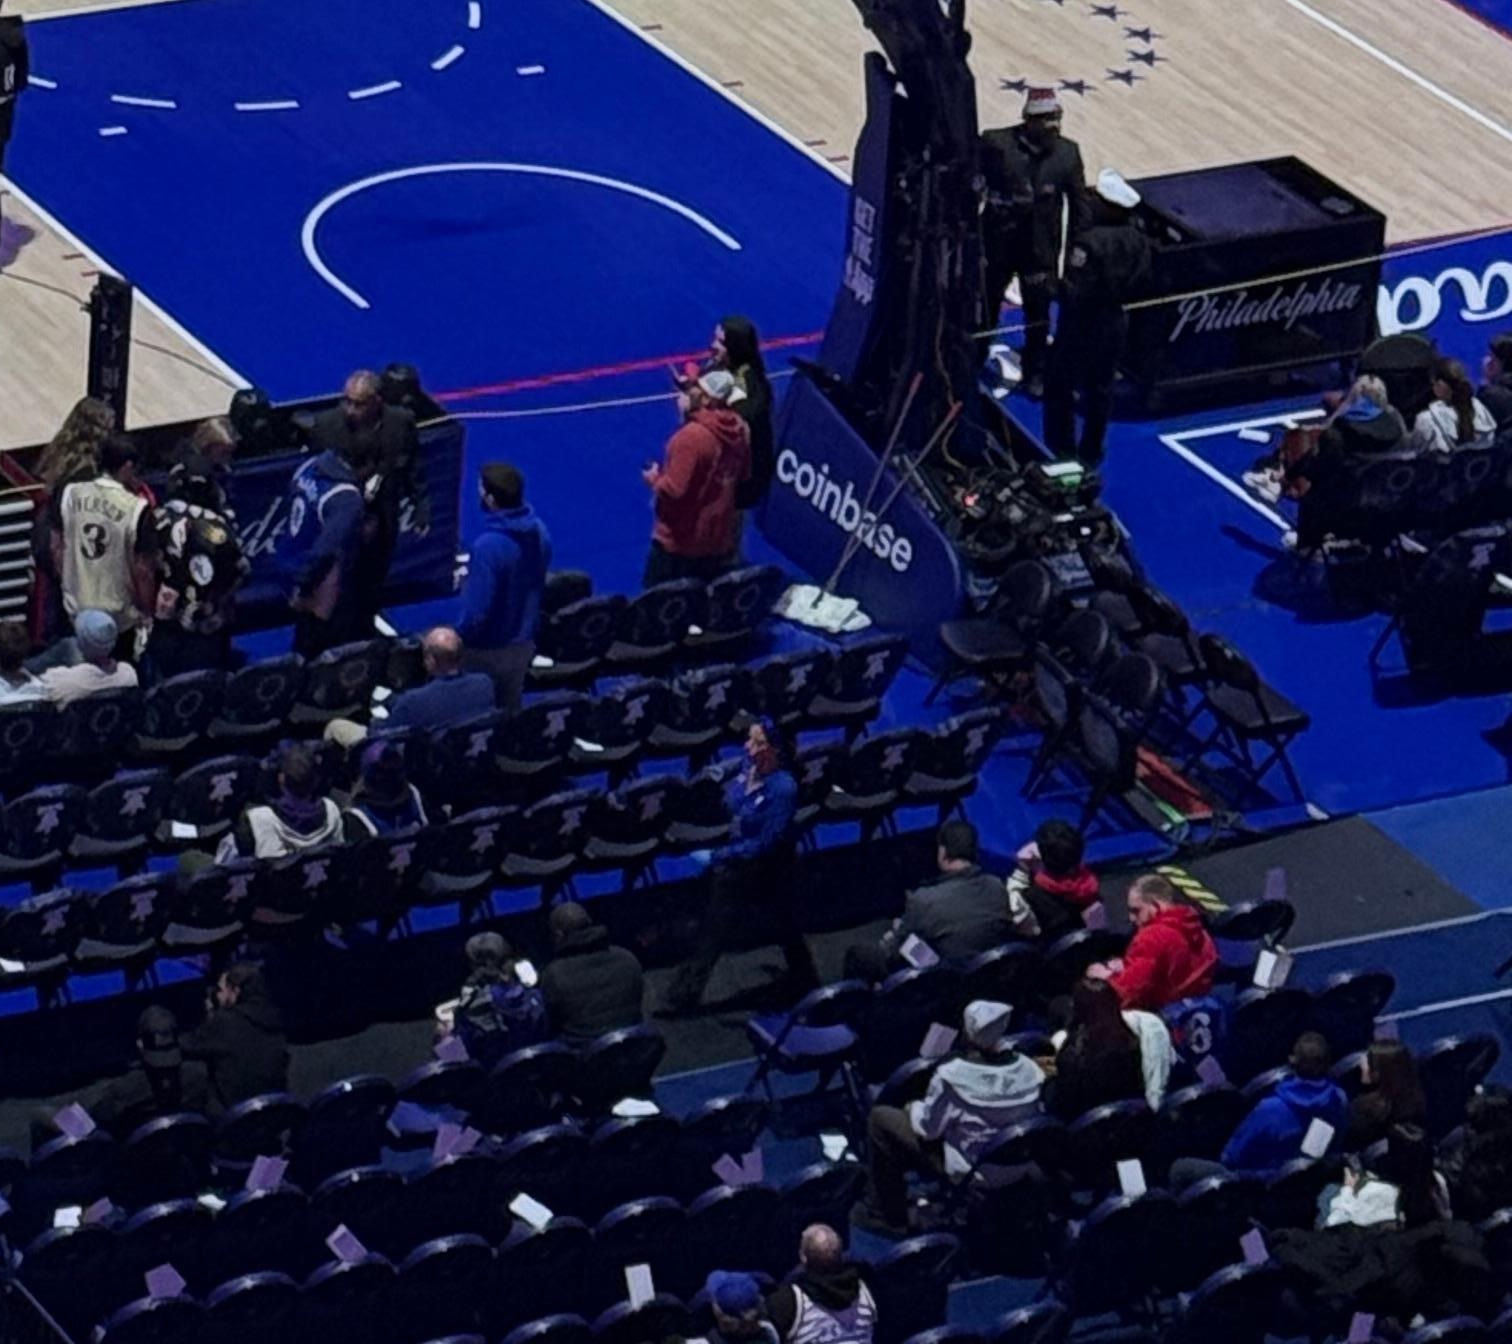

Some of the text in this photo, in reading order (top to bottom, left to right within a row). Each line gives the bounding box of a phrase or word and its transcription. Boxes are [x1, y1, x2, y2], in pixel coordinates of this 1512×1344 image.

[1168, 278, 1362, 343] Philadelphia
[80, 523, 107, 560] 3
[776, 448, 913, 572] coinbase
